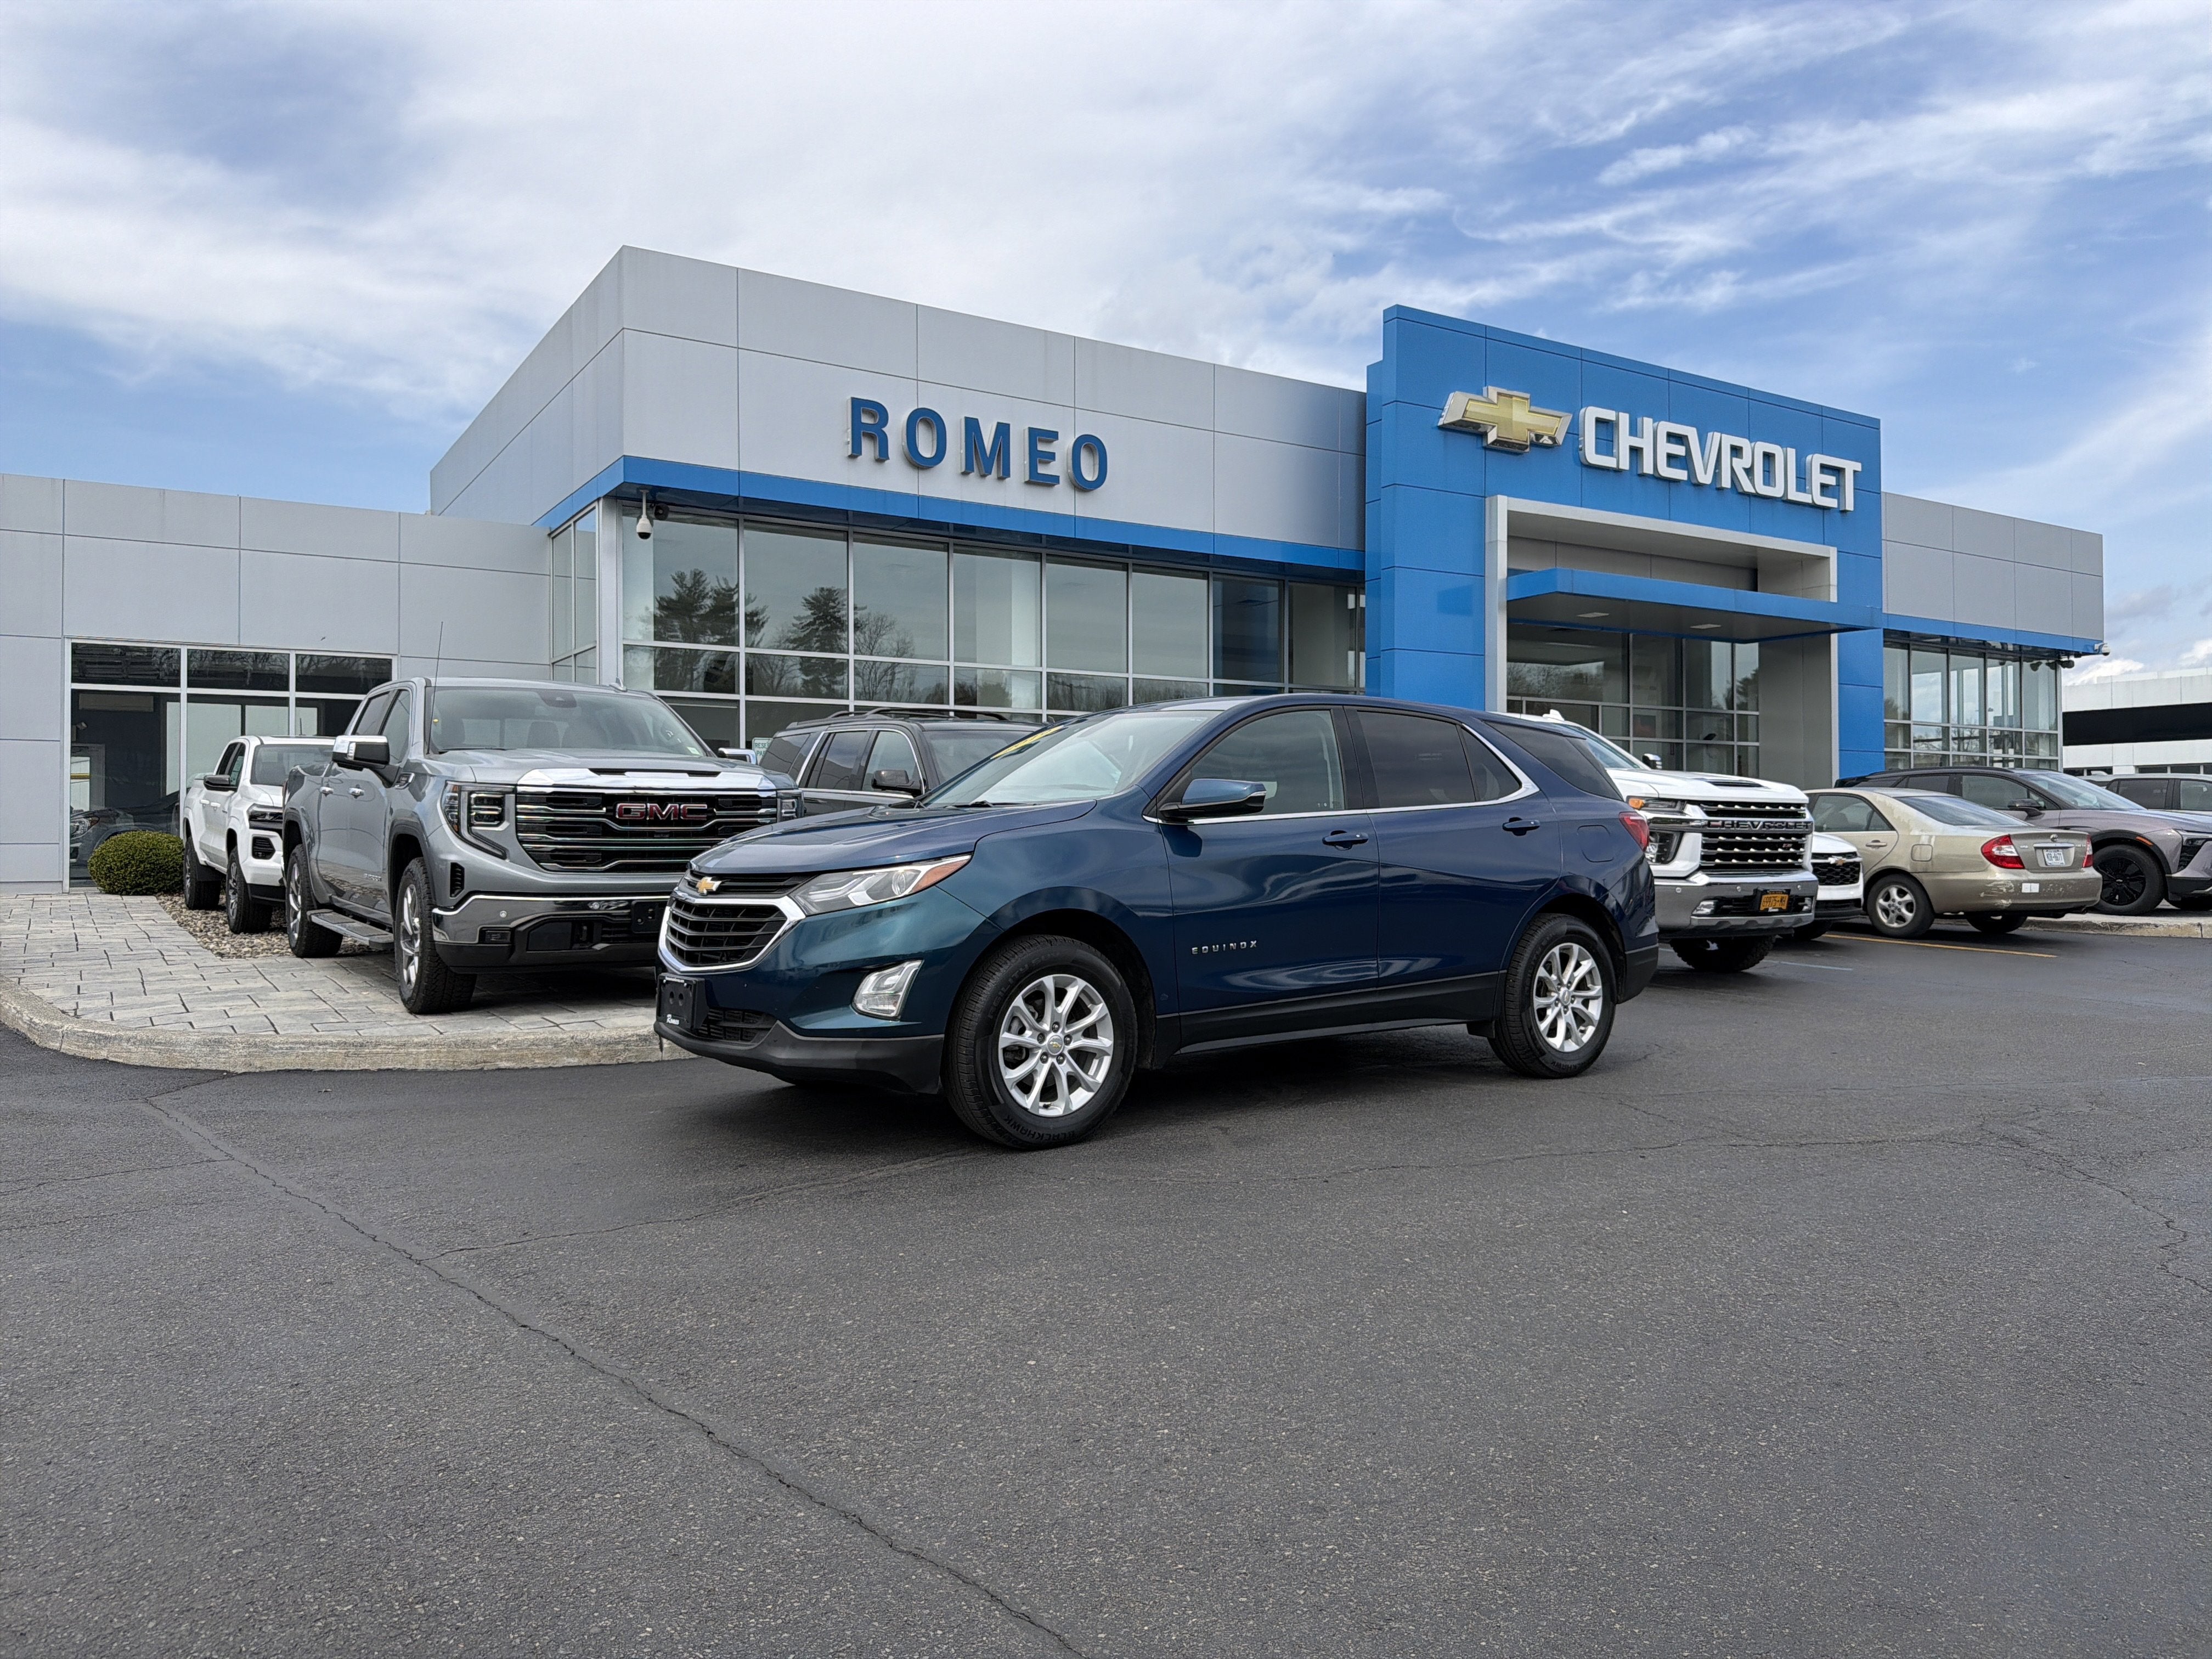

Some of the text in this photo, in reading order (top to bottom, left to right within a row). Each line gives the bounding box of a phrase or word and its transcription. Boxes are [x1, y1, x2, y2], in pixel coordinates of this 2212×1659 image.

[848, 397, 1108, 491] ROMEO
[1579, 405, 1862, 512] CHEVROLET
[616, 803, 708, 820] GMC
[1706, 820, 1811, 831] CHEVROLET
[1192, 940, 1257, 955] EQUINOX
